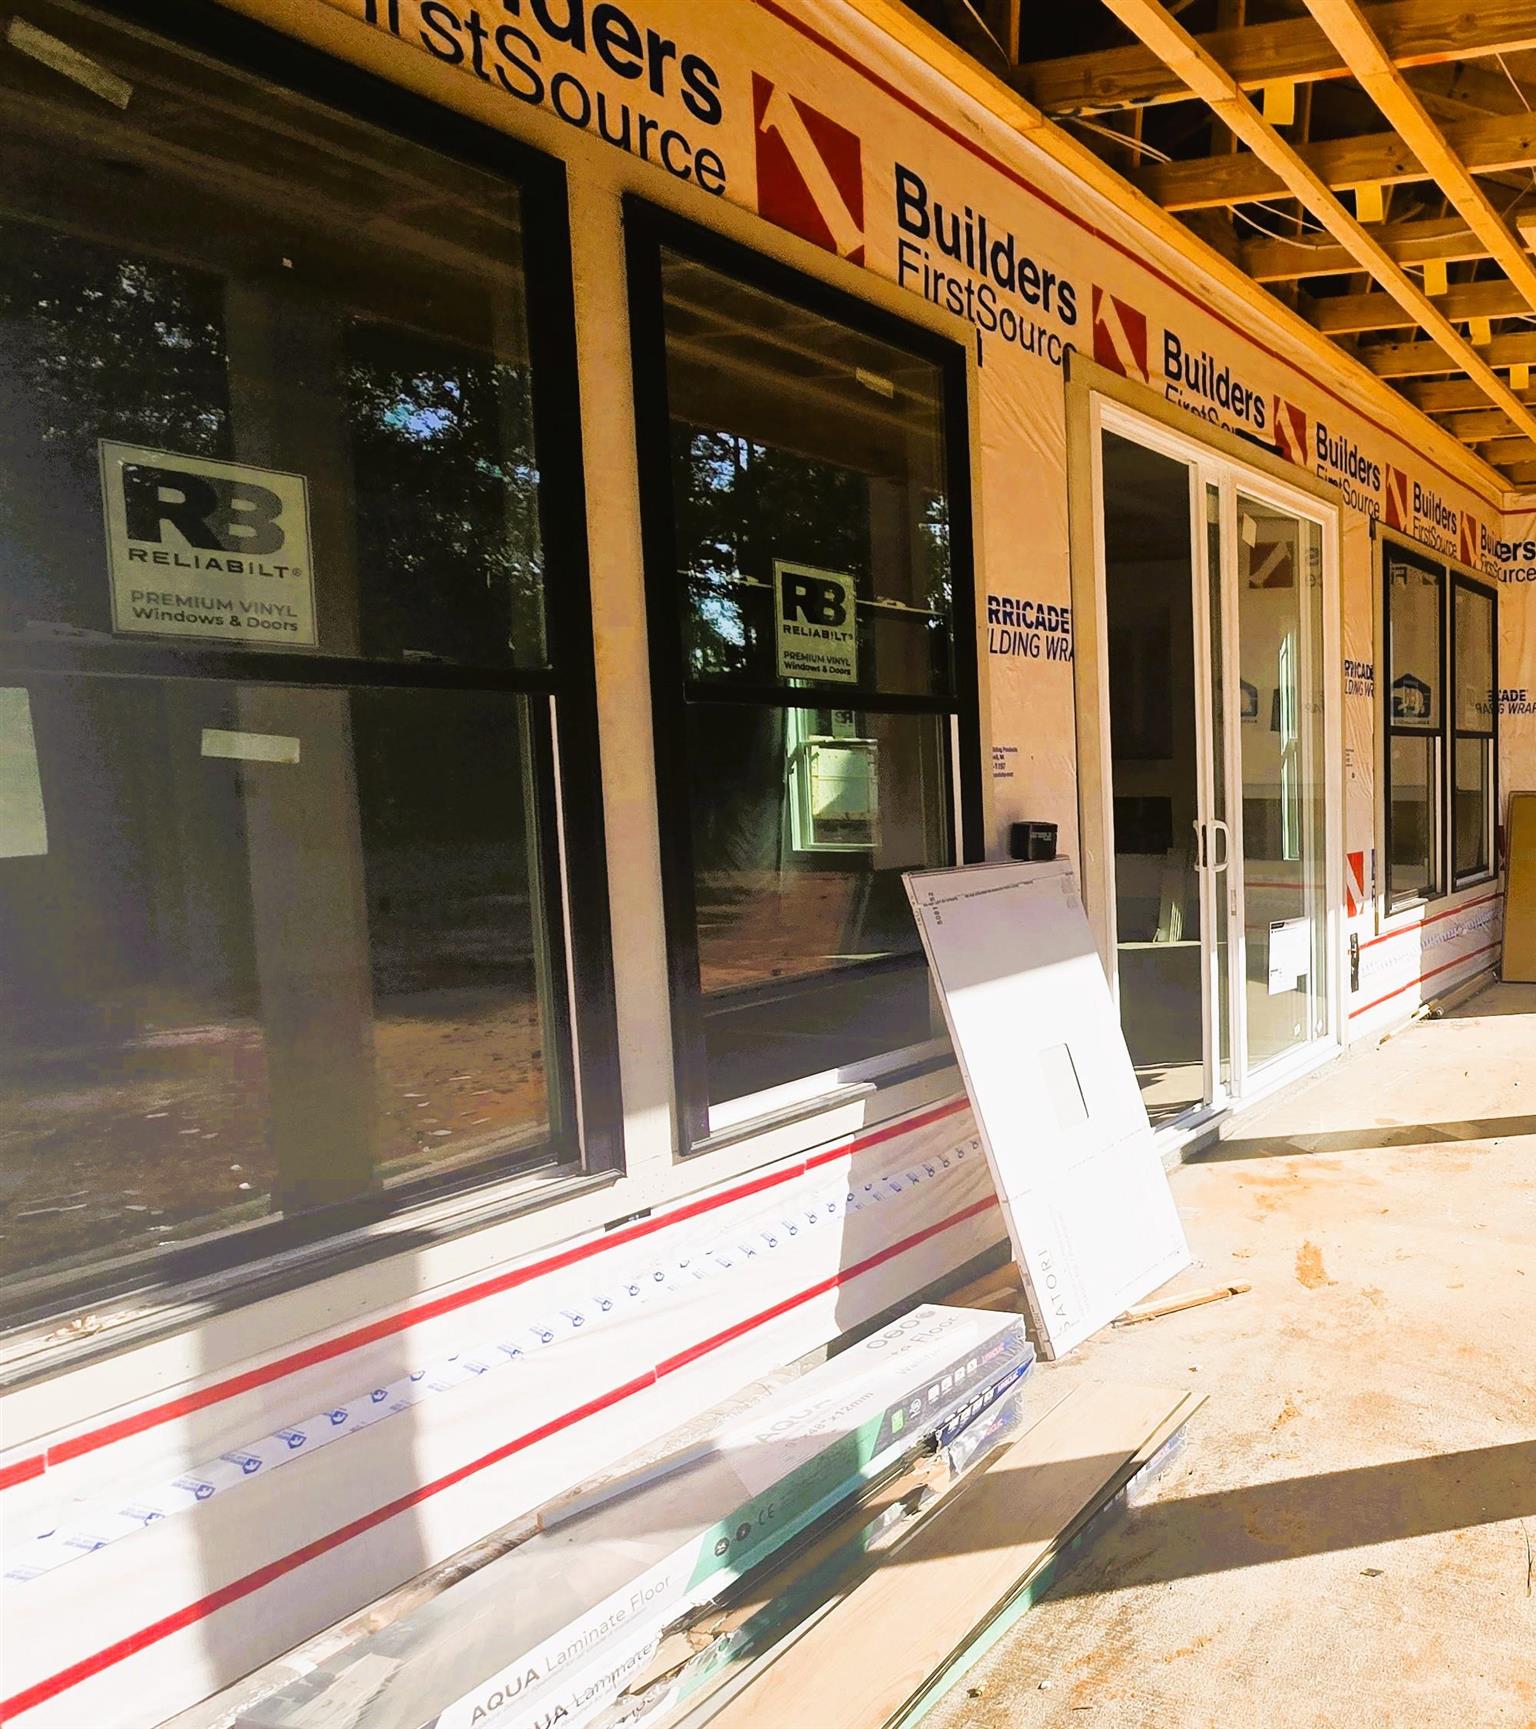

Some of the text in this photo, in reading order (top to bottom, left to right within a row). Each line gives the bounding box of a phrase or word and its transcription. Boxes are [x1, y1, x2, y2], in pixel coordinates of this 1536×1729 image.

[503, 0, 722, 126] ders
[895, 162, 1077, 326] Builders
[1163, 329, 1265, 429] Builders
[1316, 421, 1381, 492] Builders
[1413, 481, 1457, 535] Builders
[128, 548, 289, 579] RELIABILT
[131, 590, 297, 618] PREMIUM VINYL
[132, 607, 224, 626] Windows
[247, 617, 298, 632] Doors
[781, 571, 847, 627] RB
[783, 625, 848, 641] RELIABILT
[783, 651, 825, 663] PREMIUM
[470, 1667, 541, 1727] AQUA
[545, 1608, 626, 1673] Laminate
[629, 1575, 671, 1612] Floor
